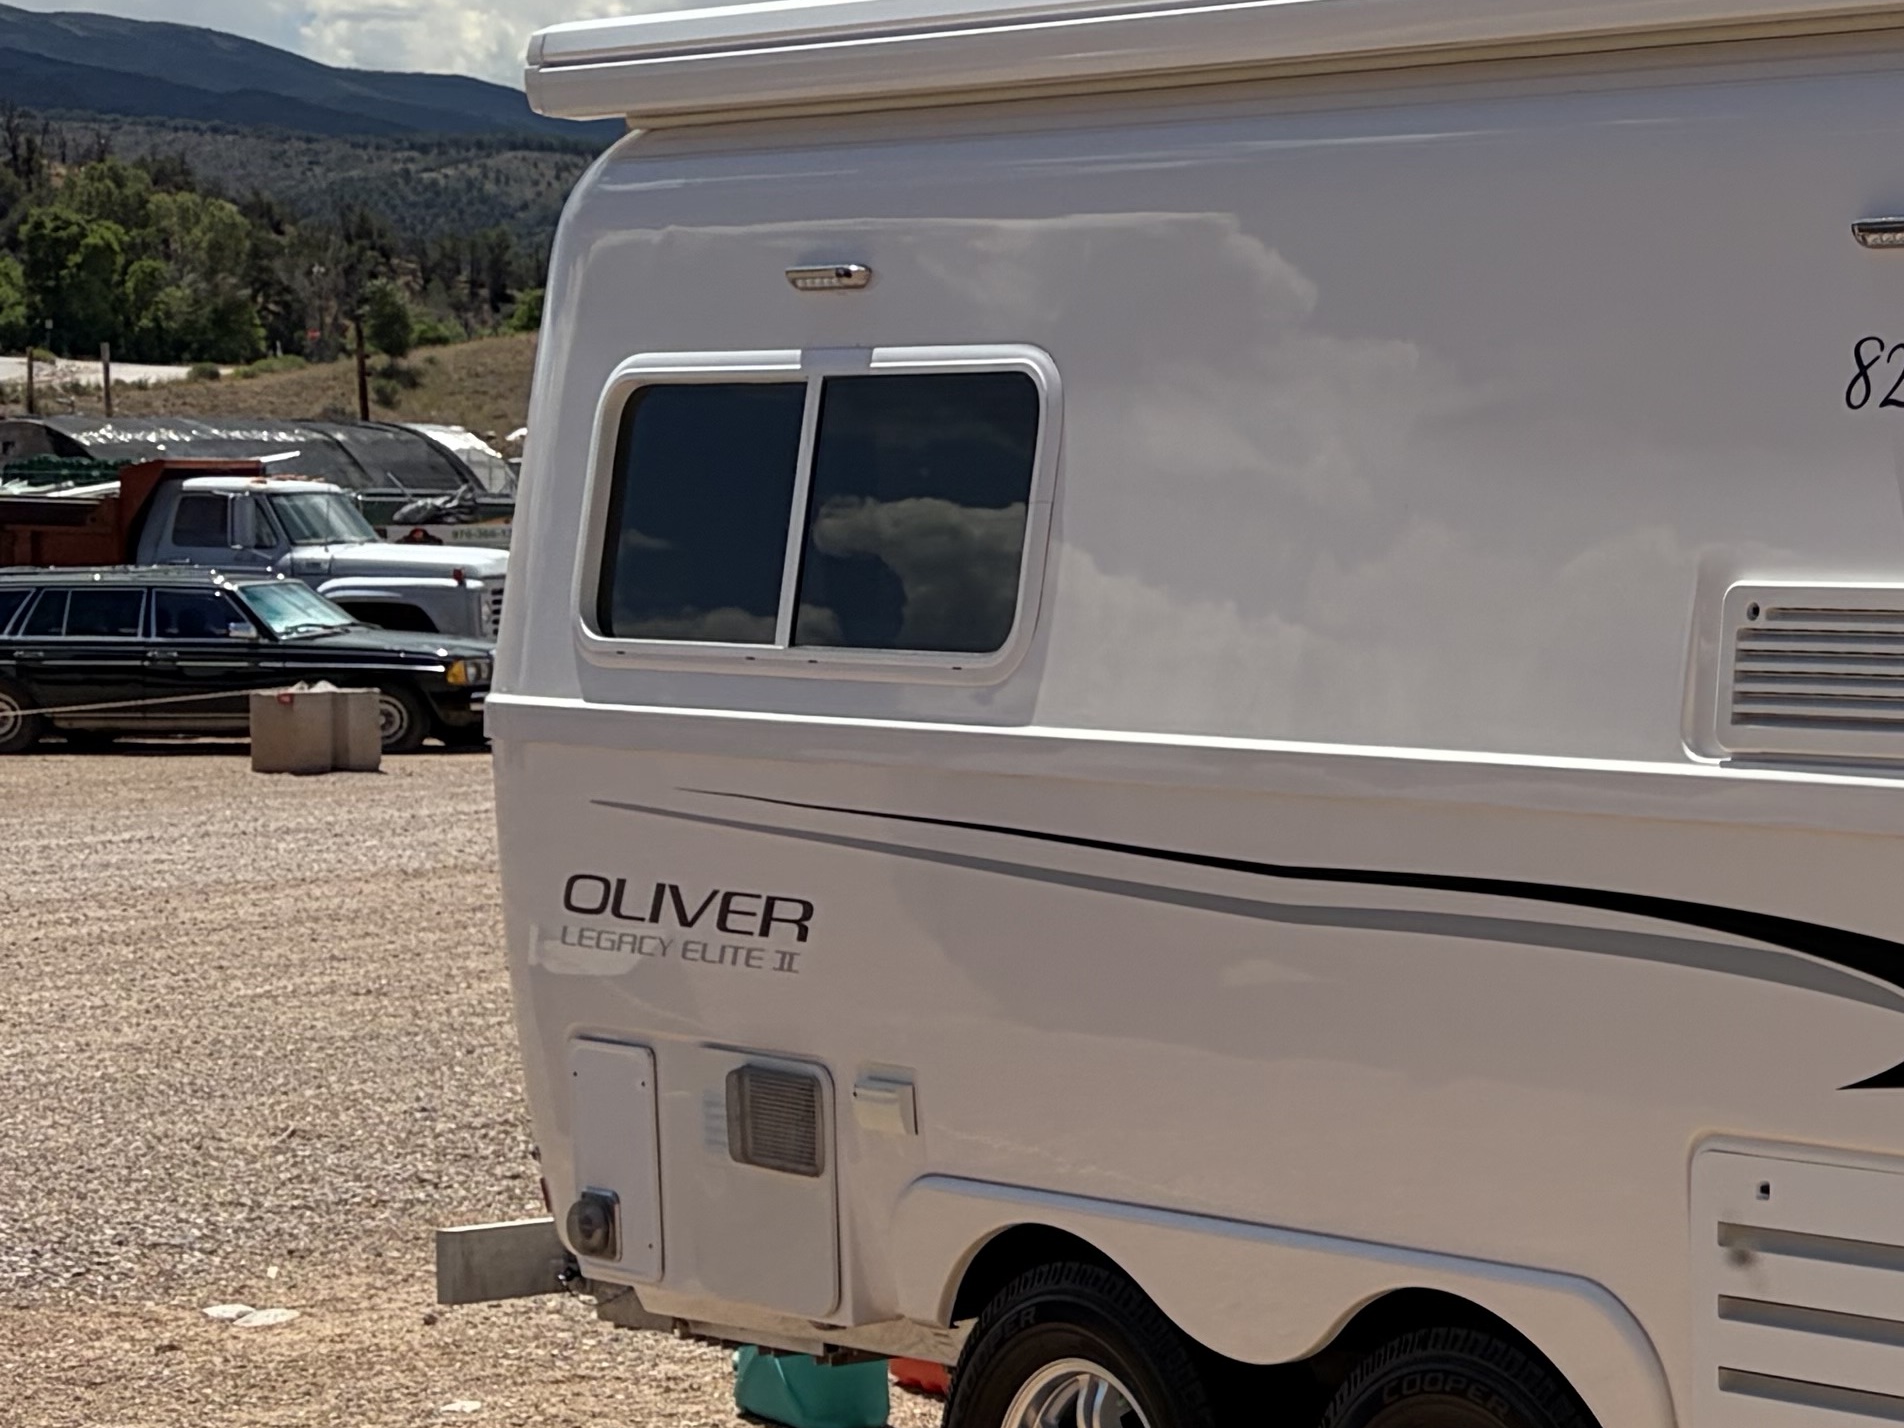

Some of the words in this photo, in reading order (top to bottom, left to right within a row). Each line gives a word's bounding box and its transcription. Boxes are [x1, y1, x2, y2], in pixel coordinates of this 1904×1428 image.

[563, 874, 815, 943] OLIVER
[560, 925, 674, 957] LEGACY
[681, 940, 768, 970] ELITE
[772, 949, 801, 974] II
[1382, 1372, 1511, 1420] COOPER
